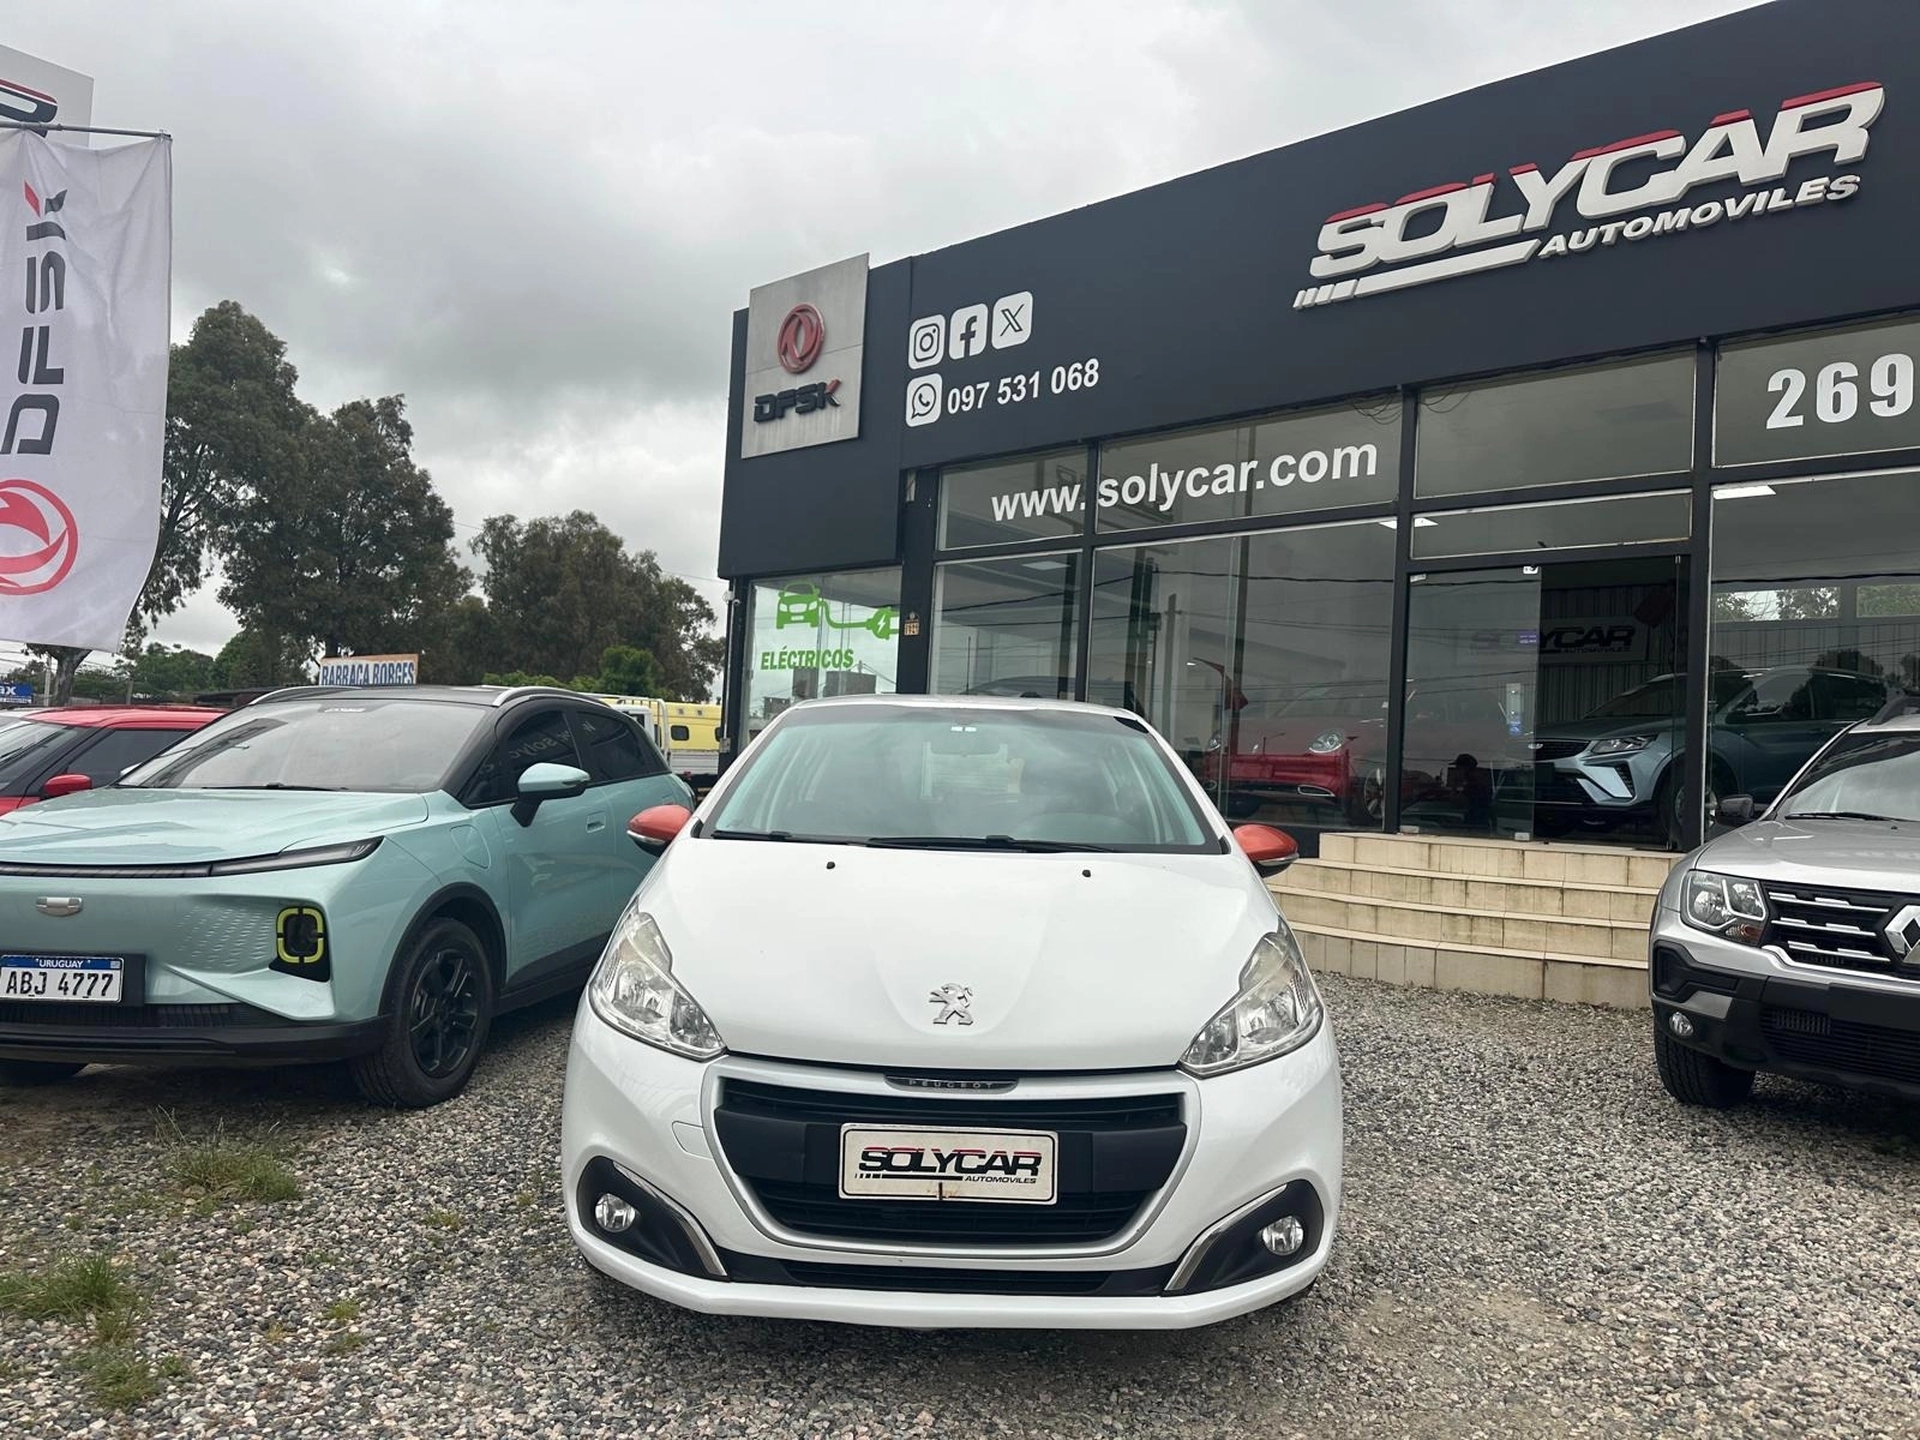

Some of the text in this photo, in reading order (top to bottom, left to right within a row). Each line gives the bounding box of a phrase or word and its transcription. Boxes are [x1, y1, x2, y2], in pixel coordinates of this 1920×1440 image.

[1309, 81, 1885, 278] SOLYCAR
[1537, 174, 1861, 258] AUTOMOVILES
[0, 180, 67, 455] DFSK
[754, 379, 841, 422] DFSK
[947, 358, 1099, 414] 097 531 068
[1766, 353, 1914, 429] 269
[373, 661, 415, 686] BORGES
[761, 646, 854, 670] ELÉCTRICOS
[39, 959, 84, 969] URUGUAY
[6, 970, 114, 997] ABJ 4777
[908, 1079, 994, 1089] PEUGEOT
[858, 1146, 1043, 1177] SOLYCAR
[964, 1174, 1037, 1185] AUTOMOVILES
